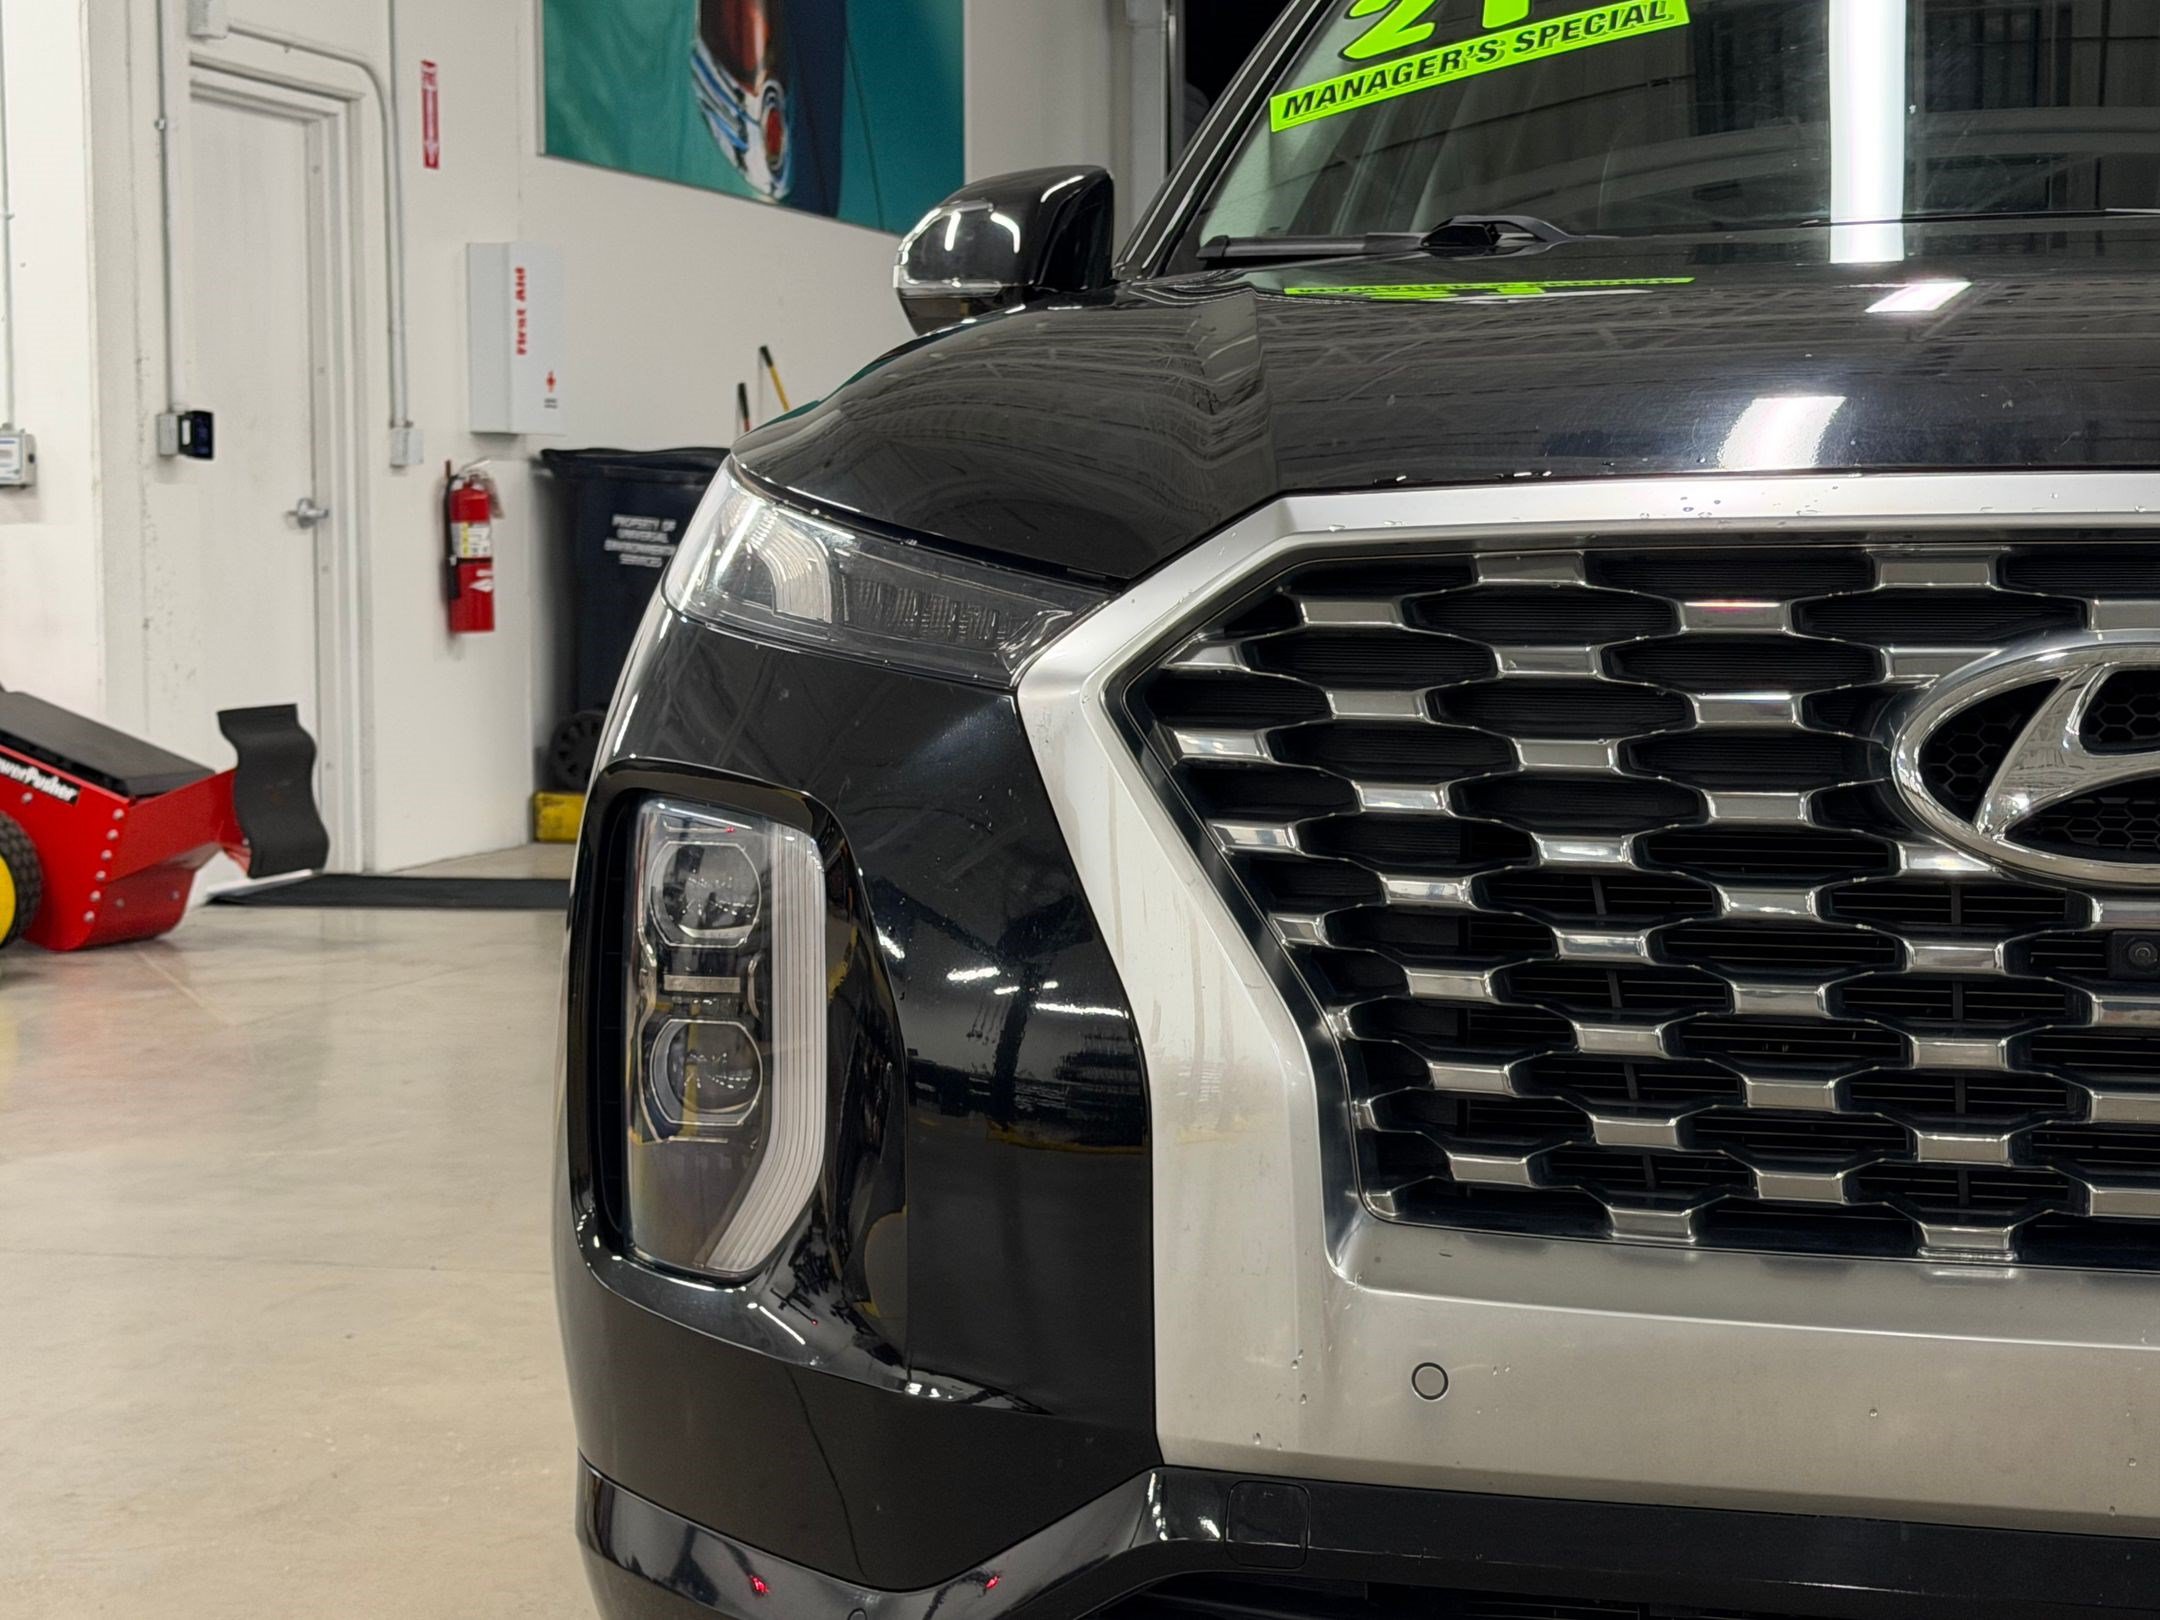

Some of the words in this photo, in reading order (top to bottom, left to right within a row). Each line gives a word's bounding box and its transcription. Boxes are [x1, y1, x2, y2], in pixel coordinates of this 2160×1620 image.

[1281, 39, 1502, 119] MANAGER'S
[1513, 1, 1673, 55] SPECIAL
[0, 758, 77, 801] werPusher
